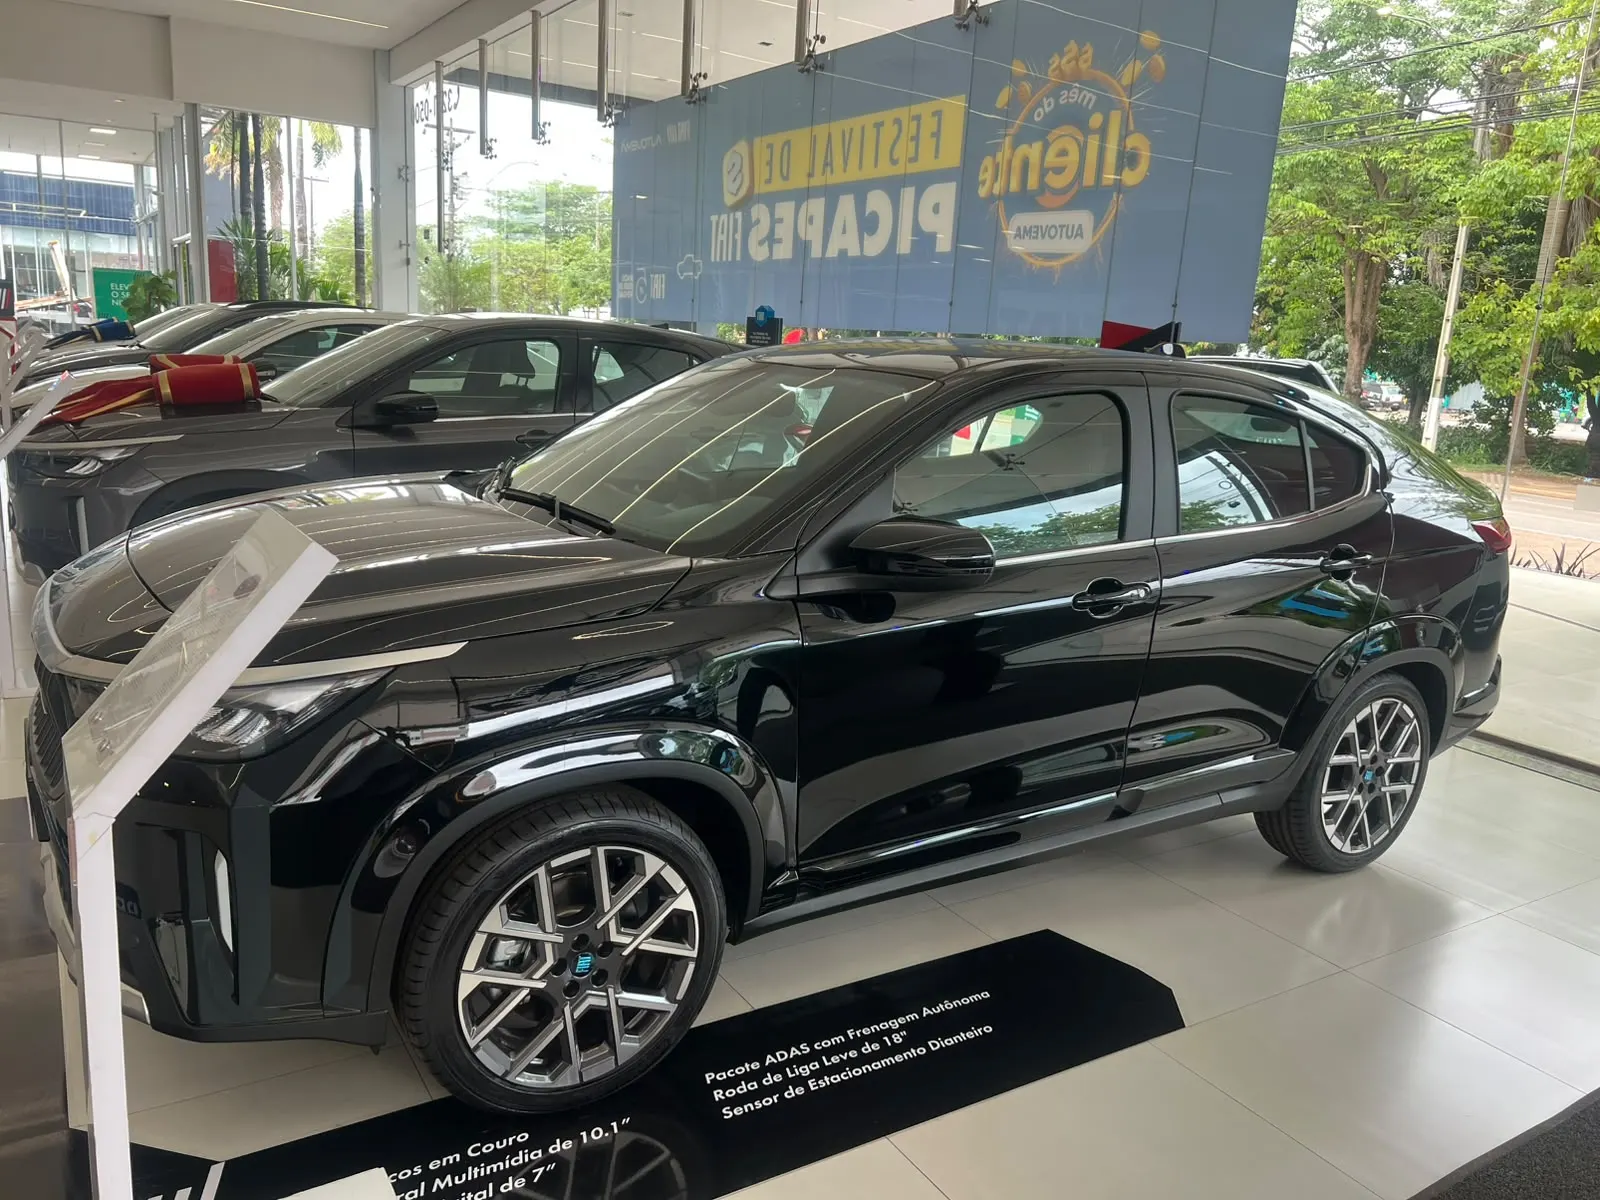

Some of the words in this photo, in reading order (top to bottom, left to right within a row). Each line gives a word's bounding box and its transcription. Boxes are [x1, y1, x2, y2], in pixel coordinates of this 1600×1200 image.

[705, 1061, 760, 1084] Pacote
[765, 1043, 810, 1066] ADAS
[814, 1035, 845, 1050] com
[847, 1012, 919, 1039] Frenagem
[922, 991, 990, 1017] Autônoma
[713, 1081, 758, 1102] Roda
[762, 1072, 783, 1086] de
[786, 1060, 820, 1078] Liga
[822, 1050, 858, 1066] Leve
[861, 1042, 880, 1054] de
[882, 1030, 907, 1047] 18"
[722, 1093, 780, 1119] Sensor
[784, 1085, 805, 1099] de
[807, 1046, 927, 1091] Estacionamento
[927, 1025, 993, 1051] Dianteiro
[388, 1164, 422, 1183] cos
[428, 1153, 460, 1170] em
[467, 1132, 529, 1157] Couro
[396, 1181, 425, 1200] ral
[432, 1149, 543, 1193] Multimídia
[549, 1138, 573, 1154] de
[580, 1117, 631, 1144] 10.1"
[462, 1182, 493, 1200] ital
[500, 1177, 526, 1193] de
[532, 1163, 556, 1183] 7"
